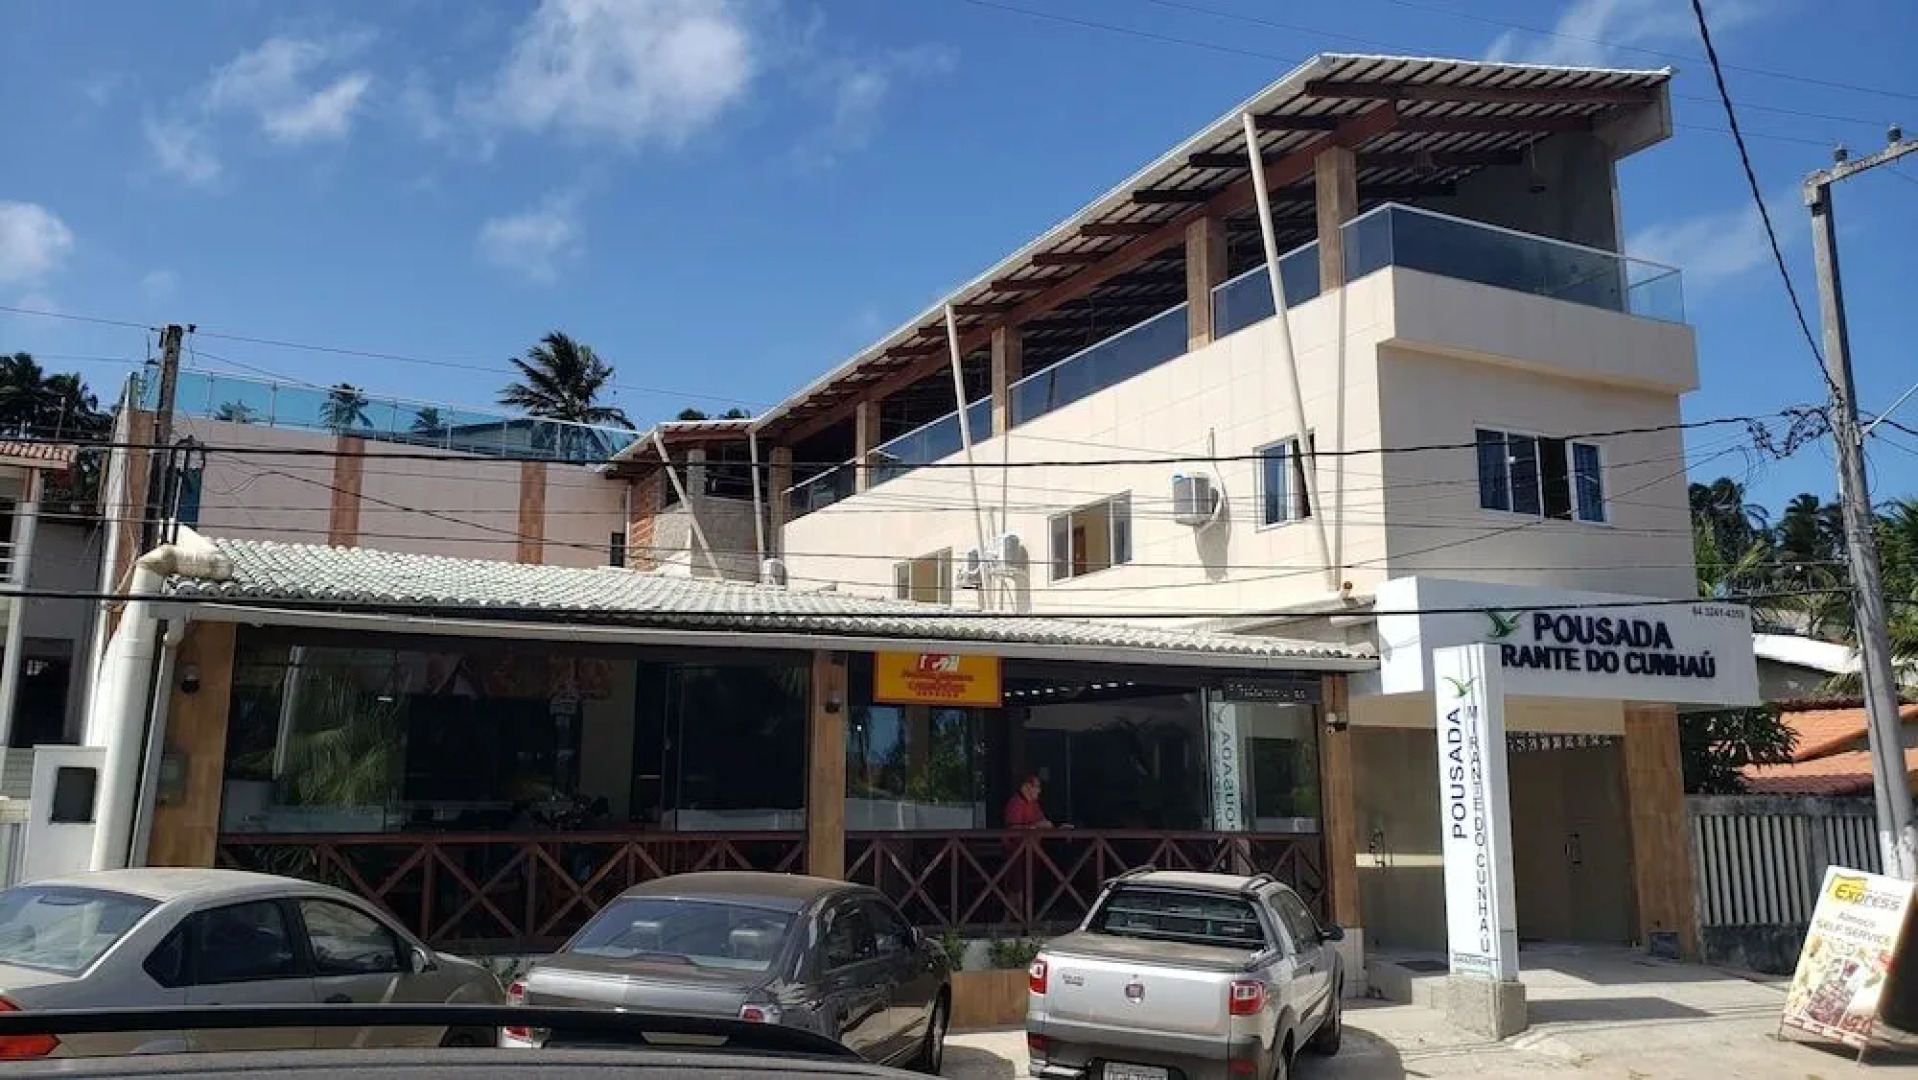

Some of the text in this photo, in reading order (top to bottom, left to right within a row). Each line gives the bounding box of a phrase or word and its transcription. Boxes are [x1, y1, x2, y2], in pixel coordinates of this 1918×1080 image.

[1532, 612, 1674, 649] POUSADA
[1501, 643, 1716, 678] RANTE DO CUNHAÚ
[1446, 707, 1468, 839] POUSADA
[1474, 816, 1485, 847] DO
